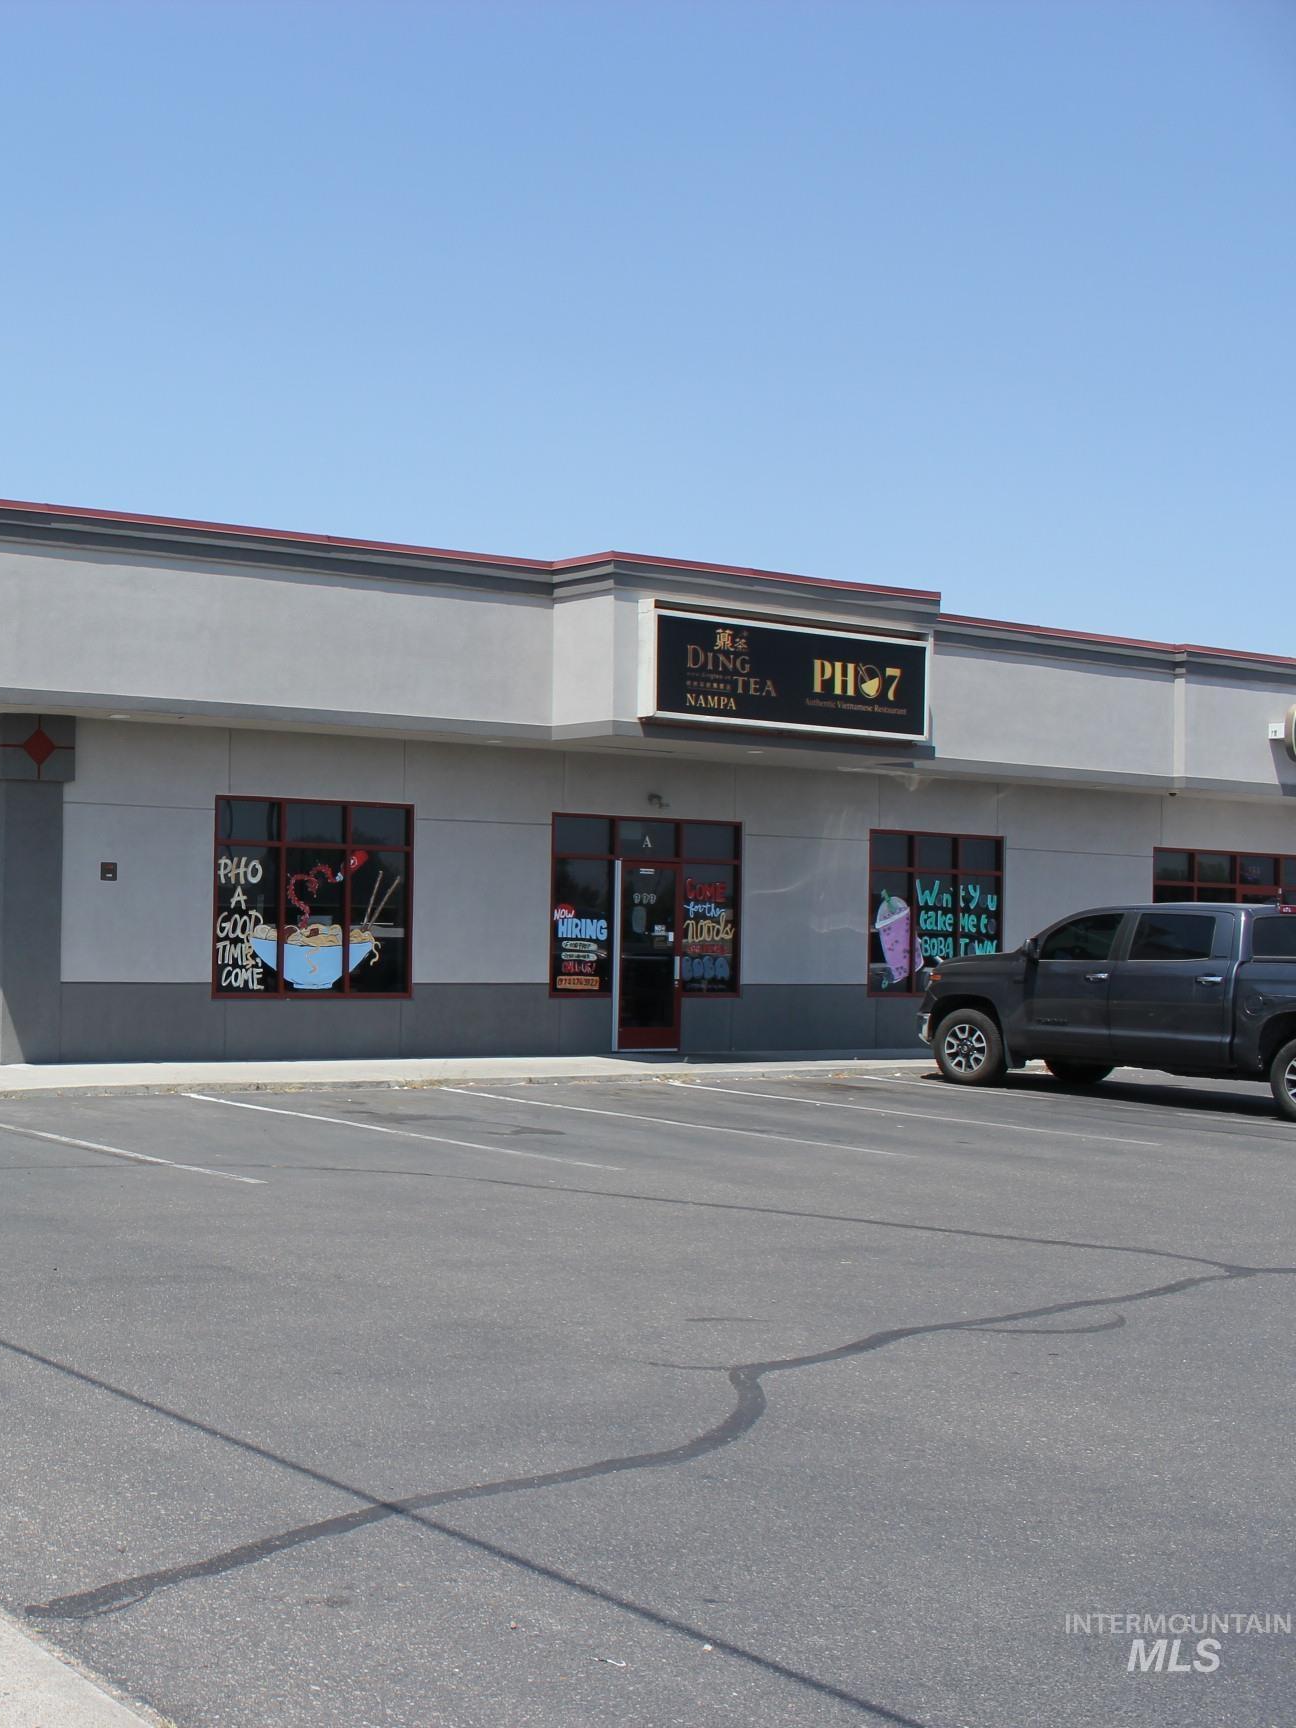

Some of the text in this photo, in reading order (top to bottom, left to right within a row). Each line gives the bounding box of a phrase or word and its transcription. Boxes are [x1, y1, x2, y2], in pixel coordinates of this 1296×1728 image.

[687, 644, 751, 674] DING
[733, 676, 777, 697] TEA
[686, 693, 737, 710] NAMPA
[643, 835, 653, 848] A
[217, 855, 263, 884] PHO
[230, 886, 247, 909] A
[687, 879, 729, 901] COME
[554, 908, 575, 920] NOW
[683, 901, 725, 918] for the
[920, 910, 954, 931] take
[216, 910, 264, 940] GOOD
[558, 918, 608, 941] HIRING
[921, 936, 954, 958] BOBA
[221, 966, 265, 991] COME
[682, 955, 730, 980] BOBA
